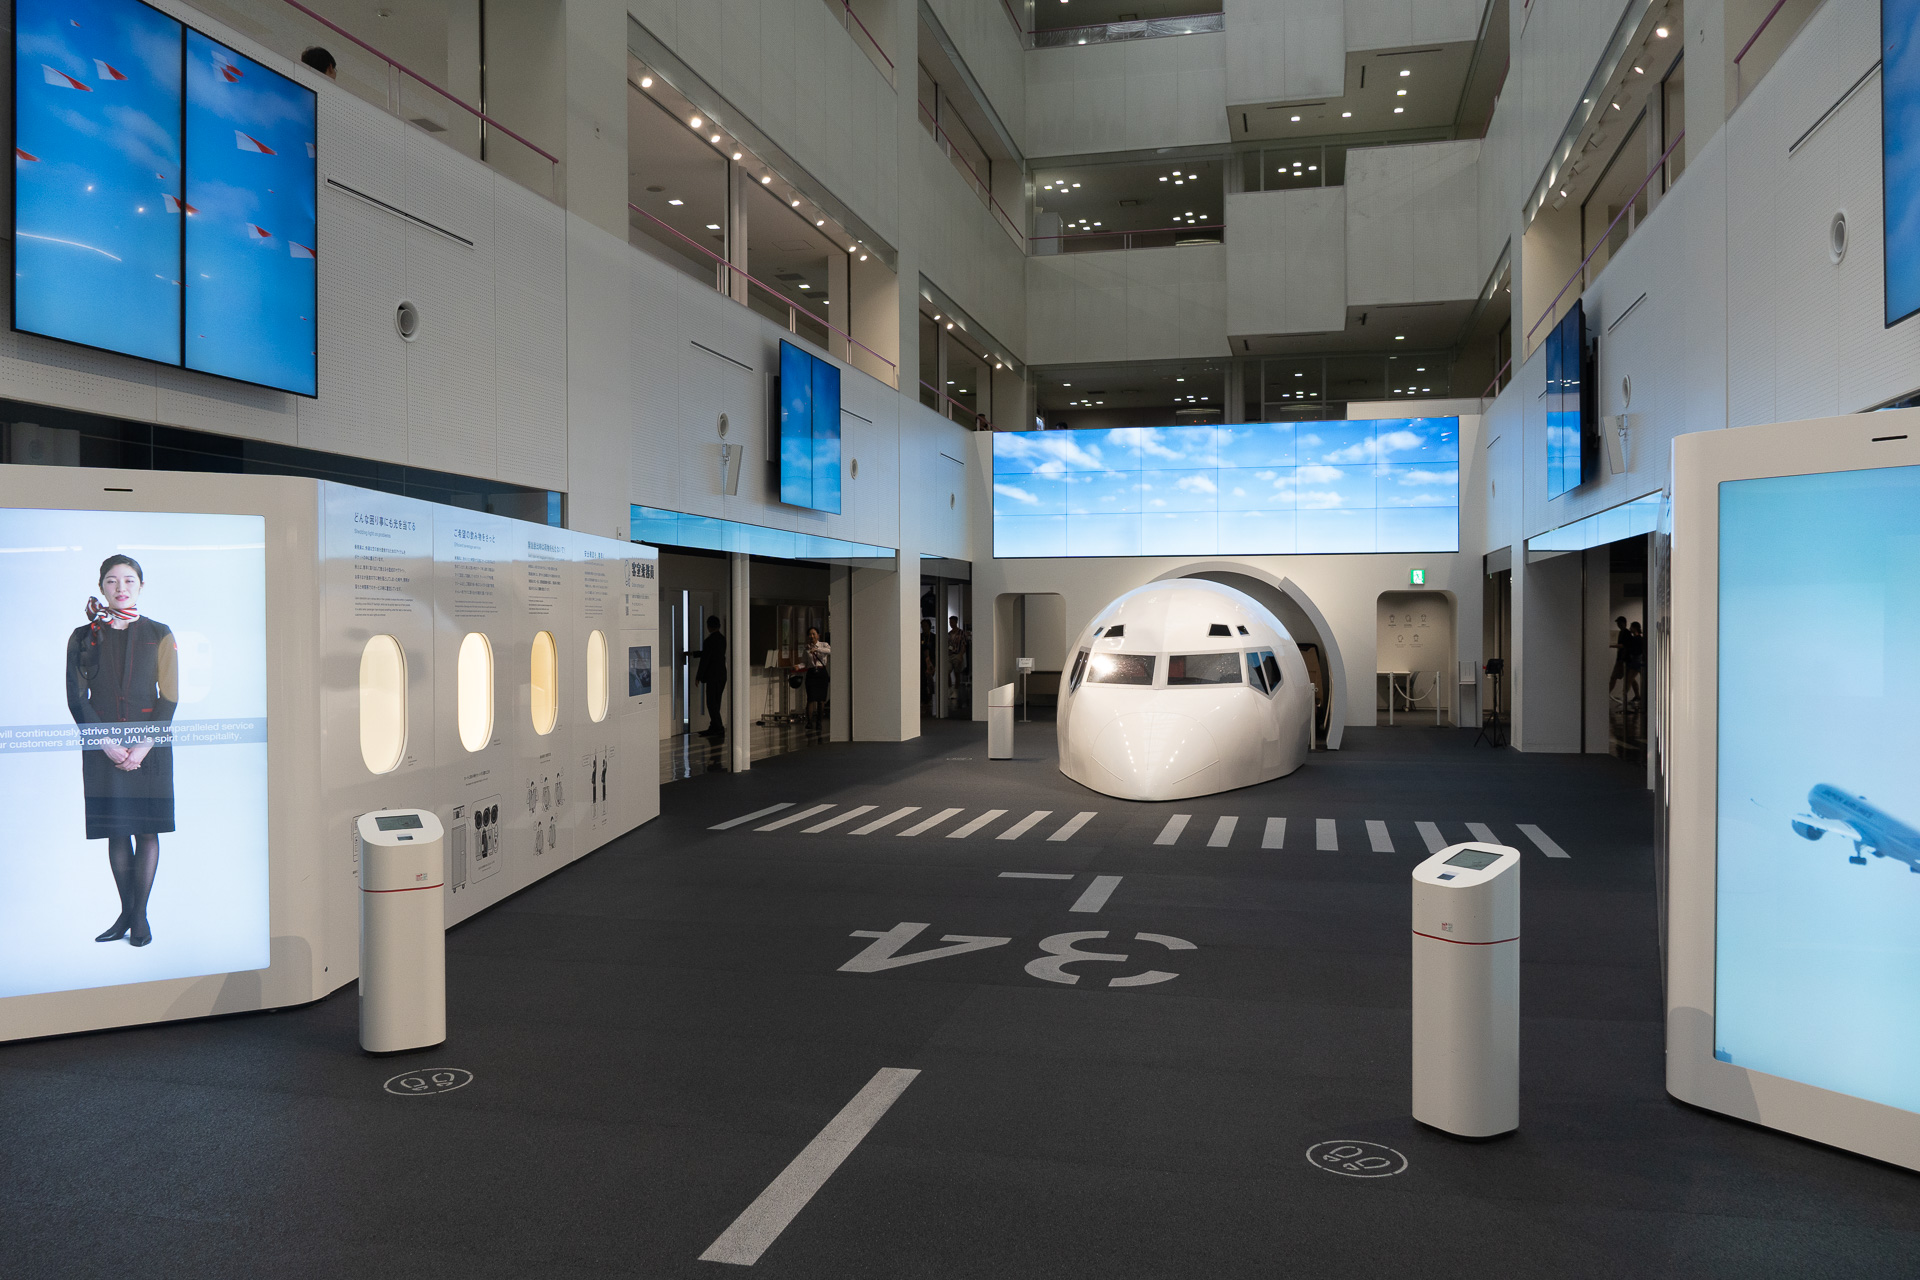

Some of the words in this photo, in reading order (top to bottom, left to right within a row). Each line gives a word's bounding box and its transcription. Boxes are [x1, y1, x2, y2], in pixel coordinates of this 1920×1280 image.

[15, 727, 81, 738] continuously
[81, 727, 109, 736] strive
[111, 727, 122, 735] to
[124, 725, 160, 735] provide
[162, 723, 219, 734] unparalleled
[221, 722, 254, 731] service
[9, 740, 63, 749] customers
[66, 738, 85, 746] and
[87, 737, 122, 747] convey
[125, 735, 153, 744] JAL's
[154, 734, 178, 744] spirit
[180, 733, 191, 742] of
[192, 732, 242, 742] hospitality.
[836, 921, 1198, 987] 34
